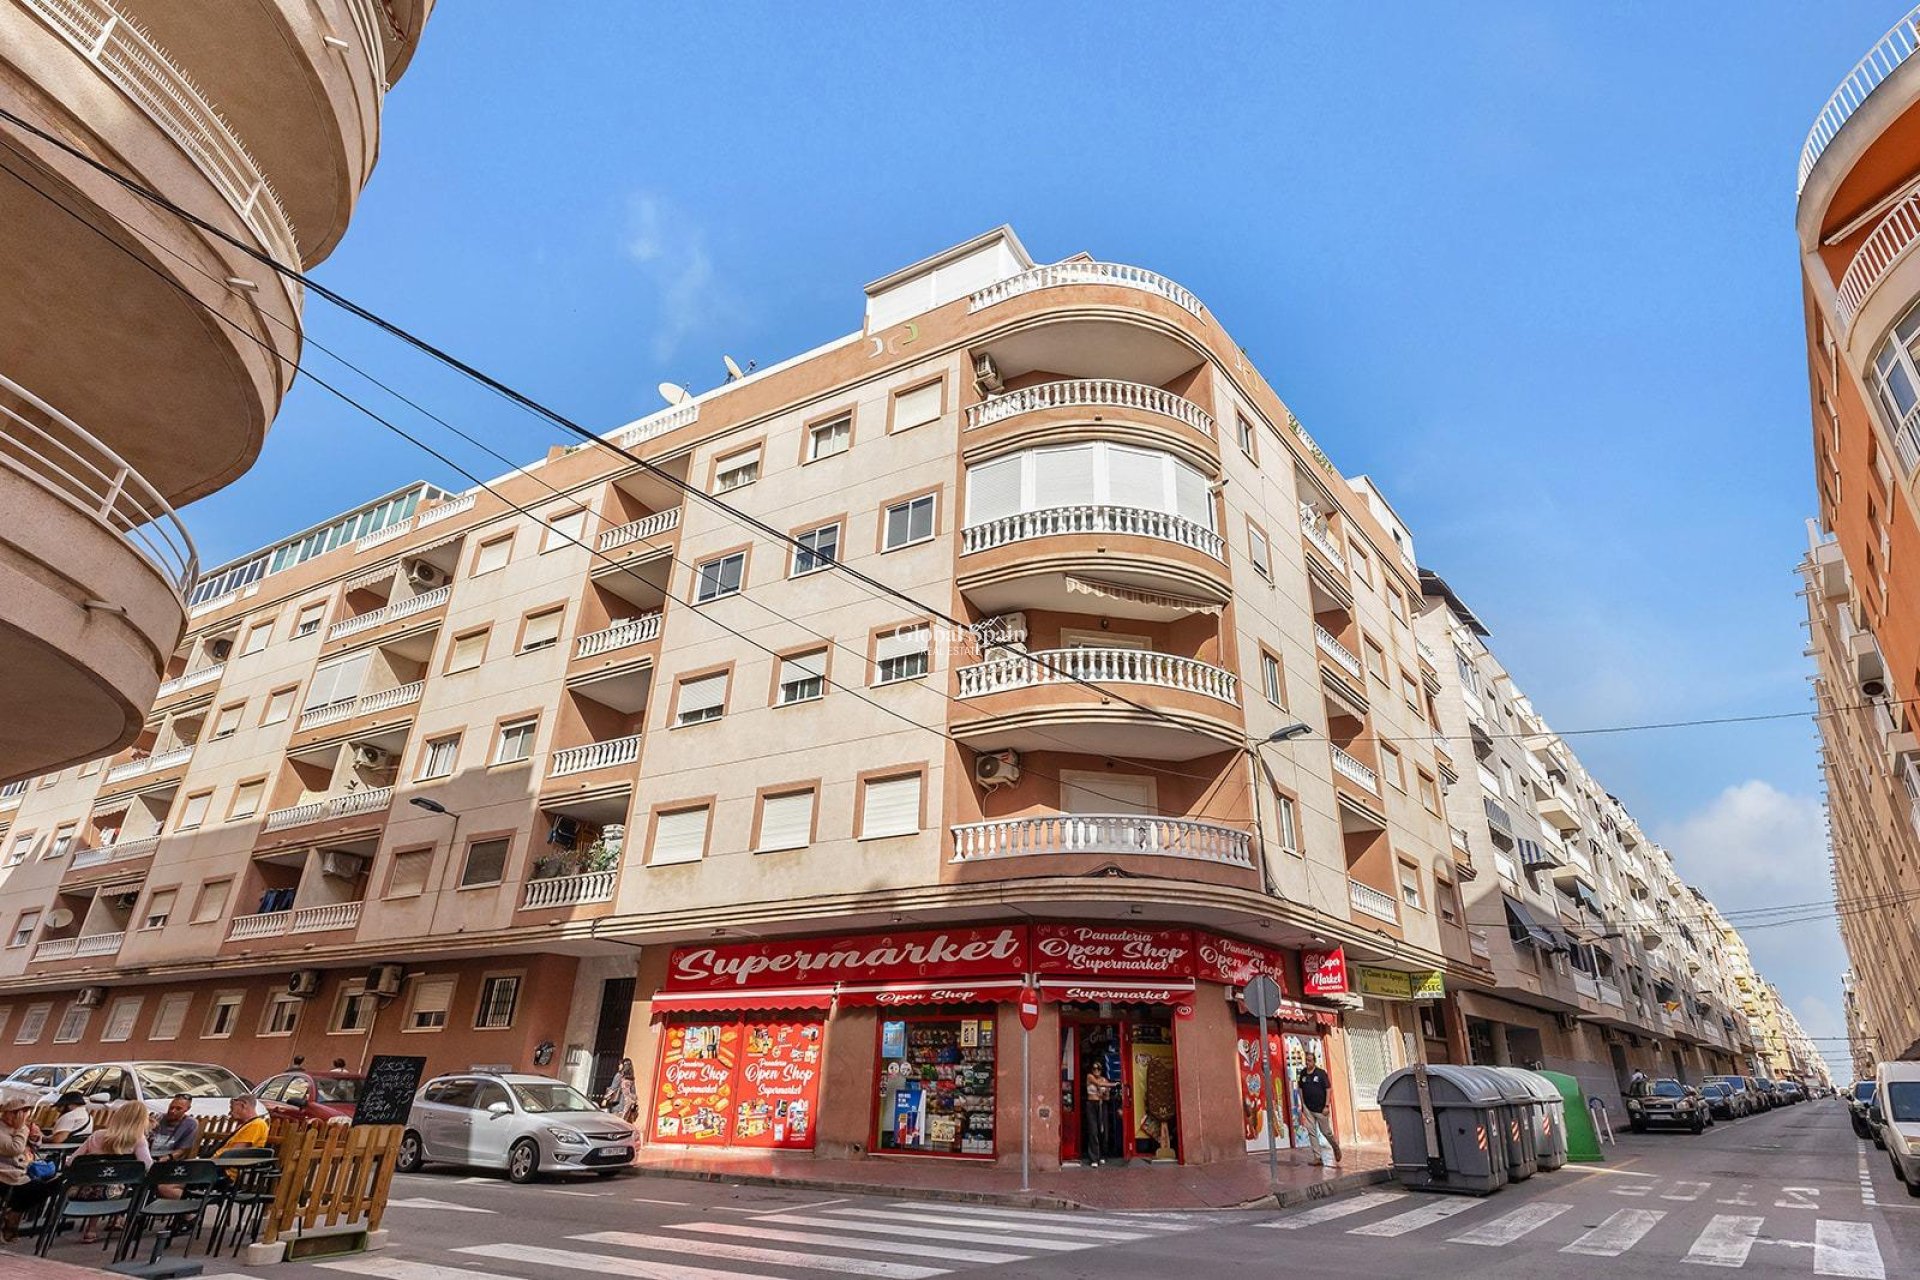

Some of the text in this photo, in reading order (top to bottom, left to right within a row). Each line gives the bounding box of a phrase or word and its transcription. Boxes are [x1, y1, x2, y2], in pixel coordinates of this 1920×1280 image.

[674, 930, 1019, 984] Supermarket
[1038, 938, 1189, 963] Open Shop
[1072, 955, 1169, 973] Supermarket
[1200, 945, 1245, 969] Open
[1247, 958, 1284, 980] Shop
[875, 990, 977, 1003] Open Shop
[1066, 988, 1170, 1000] Supermarket
[666, 1064, 729, 1086] Open Shop
[745, 1063, 815, 1086] Open Shop
[677, 1082, 718, 1096] Supermarket
[757, 1083, 802, 1098] Supermarket
